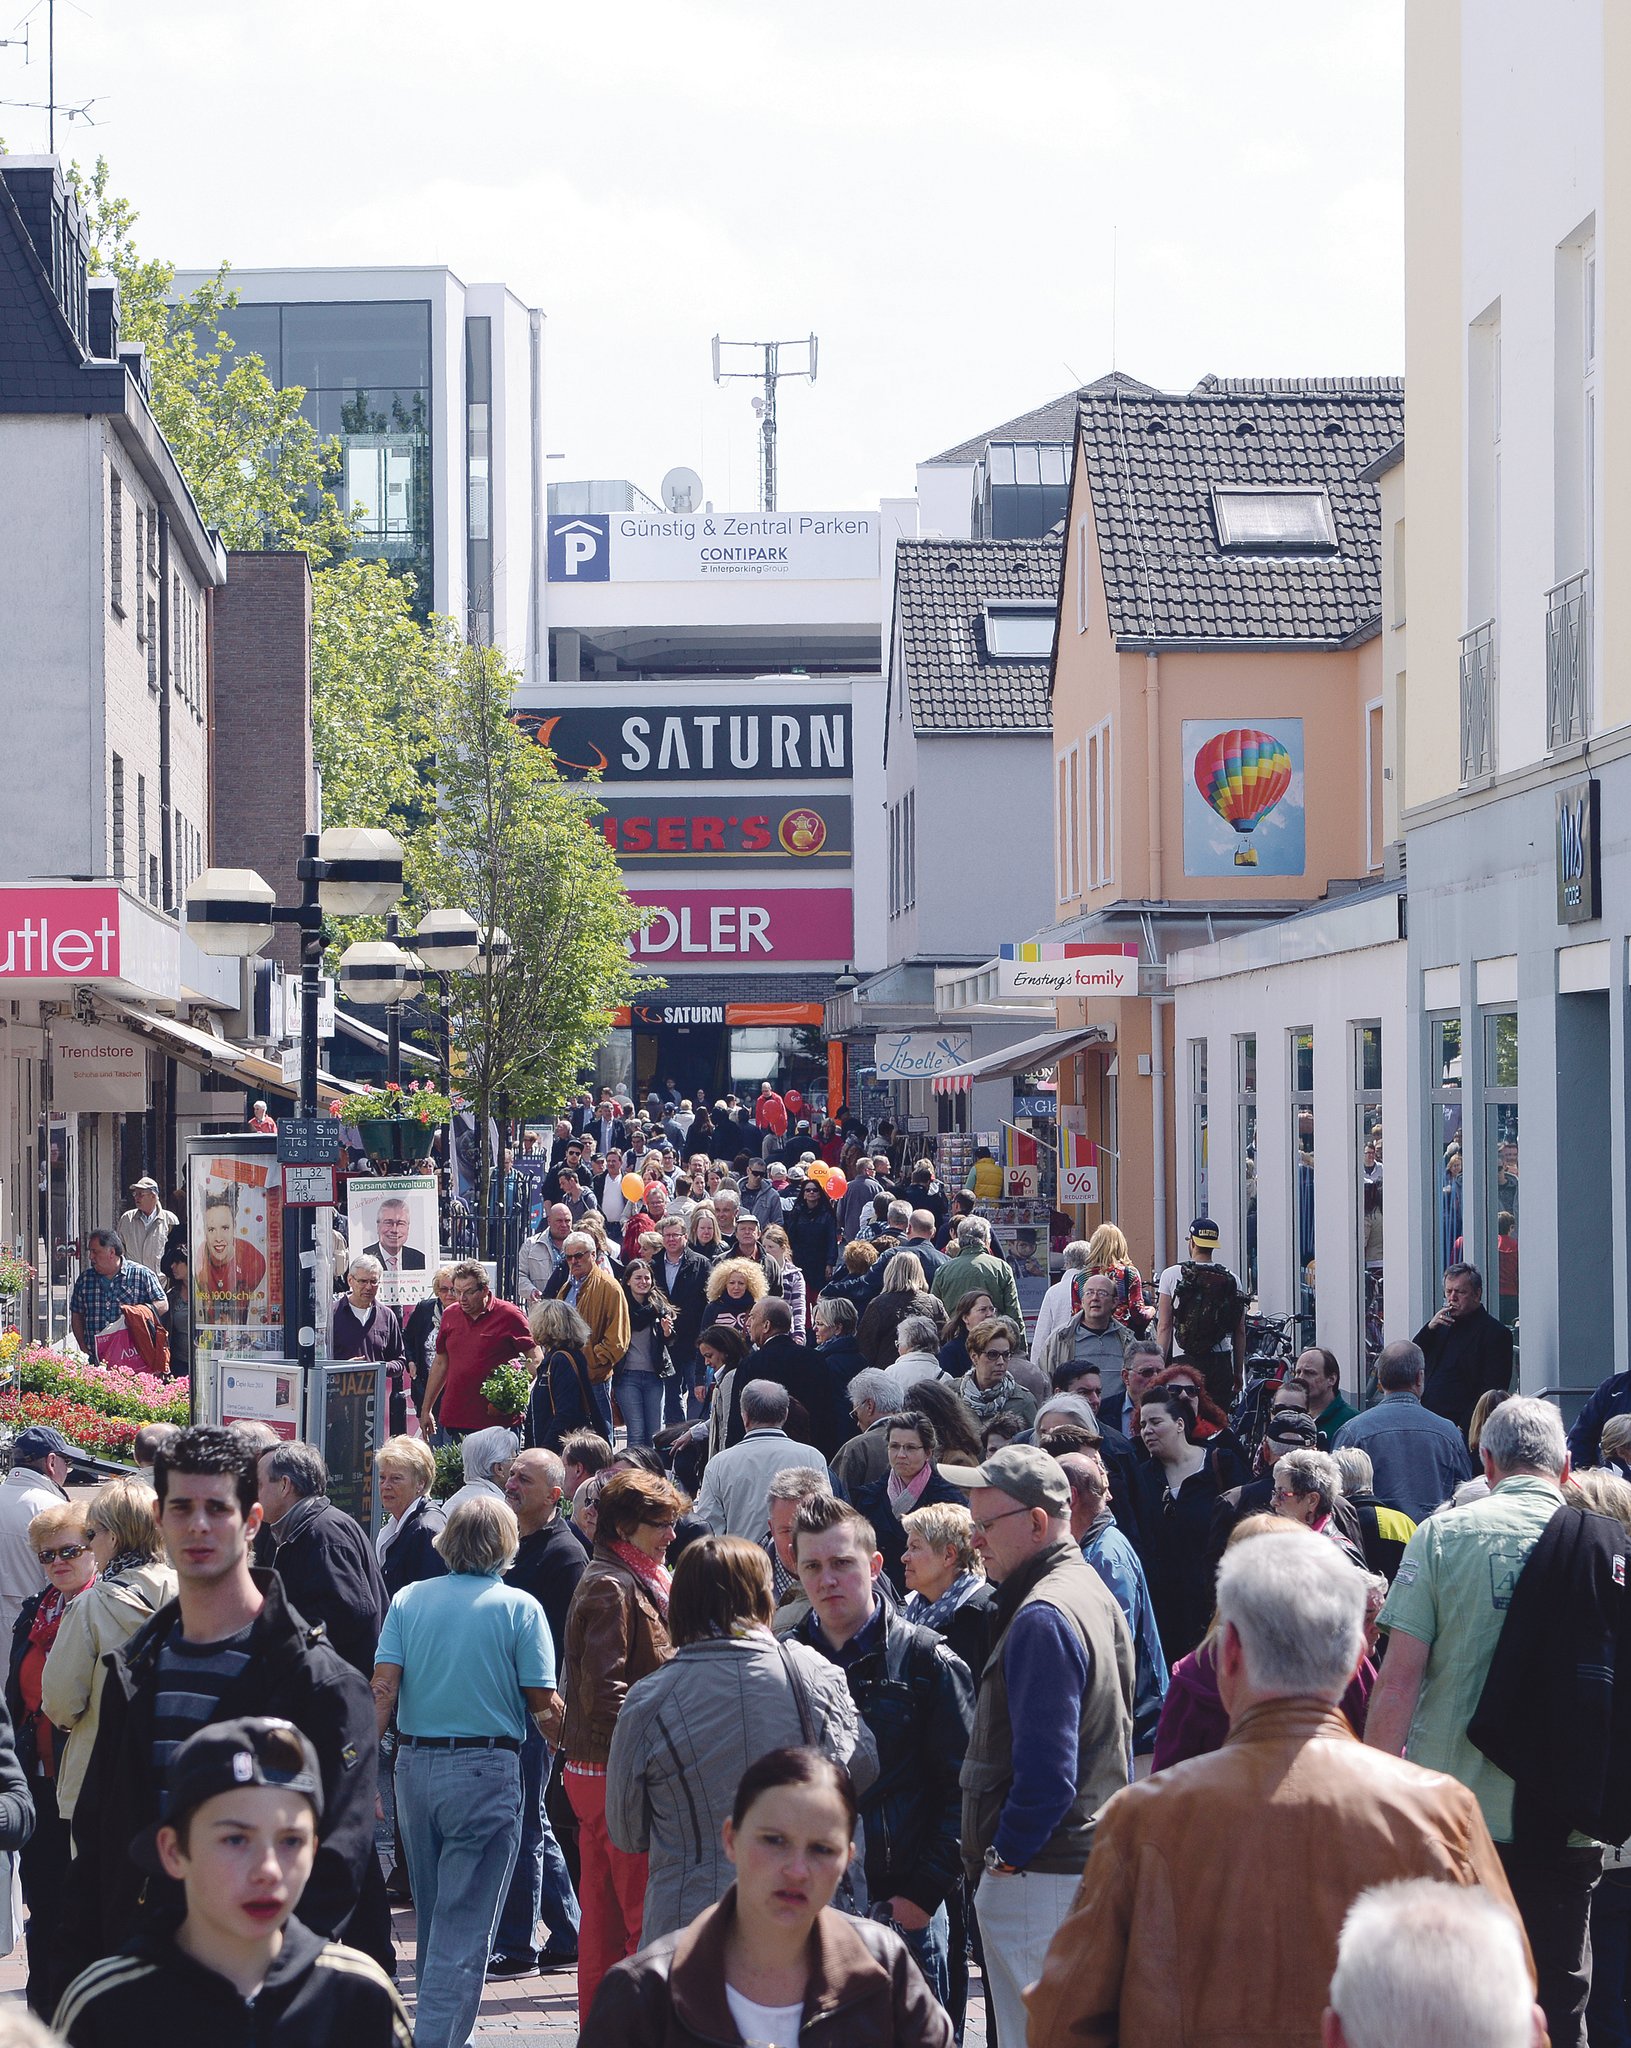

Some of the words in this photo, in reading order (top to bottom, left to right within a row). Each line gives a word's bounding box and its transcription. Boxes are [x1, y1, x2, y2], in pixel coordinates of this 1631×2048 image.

[620, 519, 696, 541] Günstig
[703, 518, 717, 536] &
[723, 517, 793, 536] Zentral
[799, 516, 869, 535] Parken
[565, 533, 598, 575] P
[700, 546, 788, 561] CONTIPARK
[621, 714, 845, 771] SATURN
[1013, 971, 1072, 991] Ernsting's
[1075, 968, 1124, 988] family
[664, 1006, 724, 1025] SATURN
[59, 1045, 134, 1058] Trendstore
[880, 1035, 943, 1078] Libelle
[100, 1070, 113, 1078] und
[115, 1070, 142, 1078] Taschen
[286, 1124, 294, 1135] S
[316, 1124, 324, 1135] S
[295, 1168, 302, 1178] H
[309, 1167, 322, 1177] 32
[350, 1181, 387, 1191] Sparsame
[388, 1179, 434, 1189] Verwaltung!
[340, 1372, 375, 1397] JAZZ
